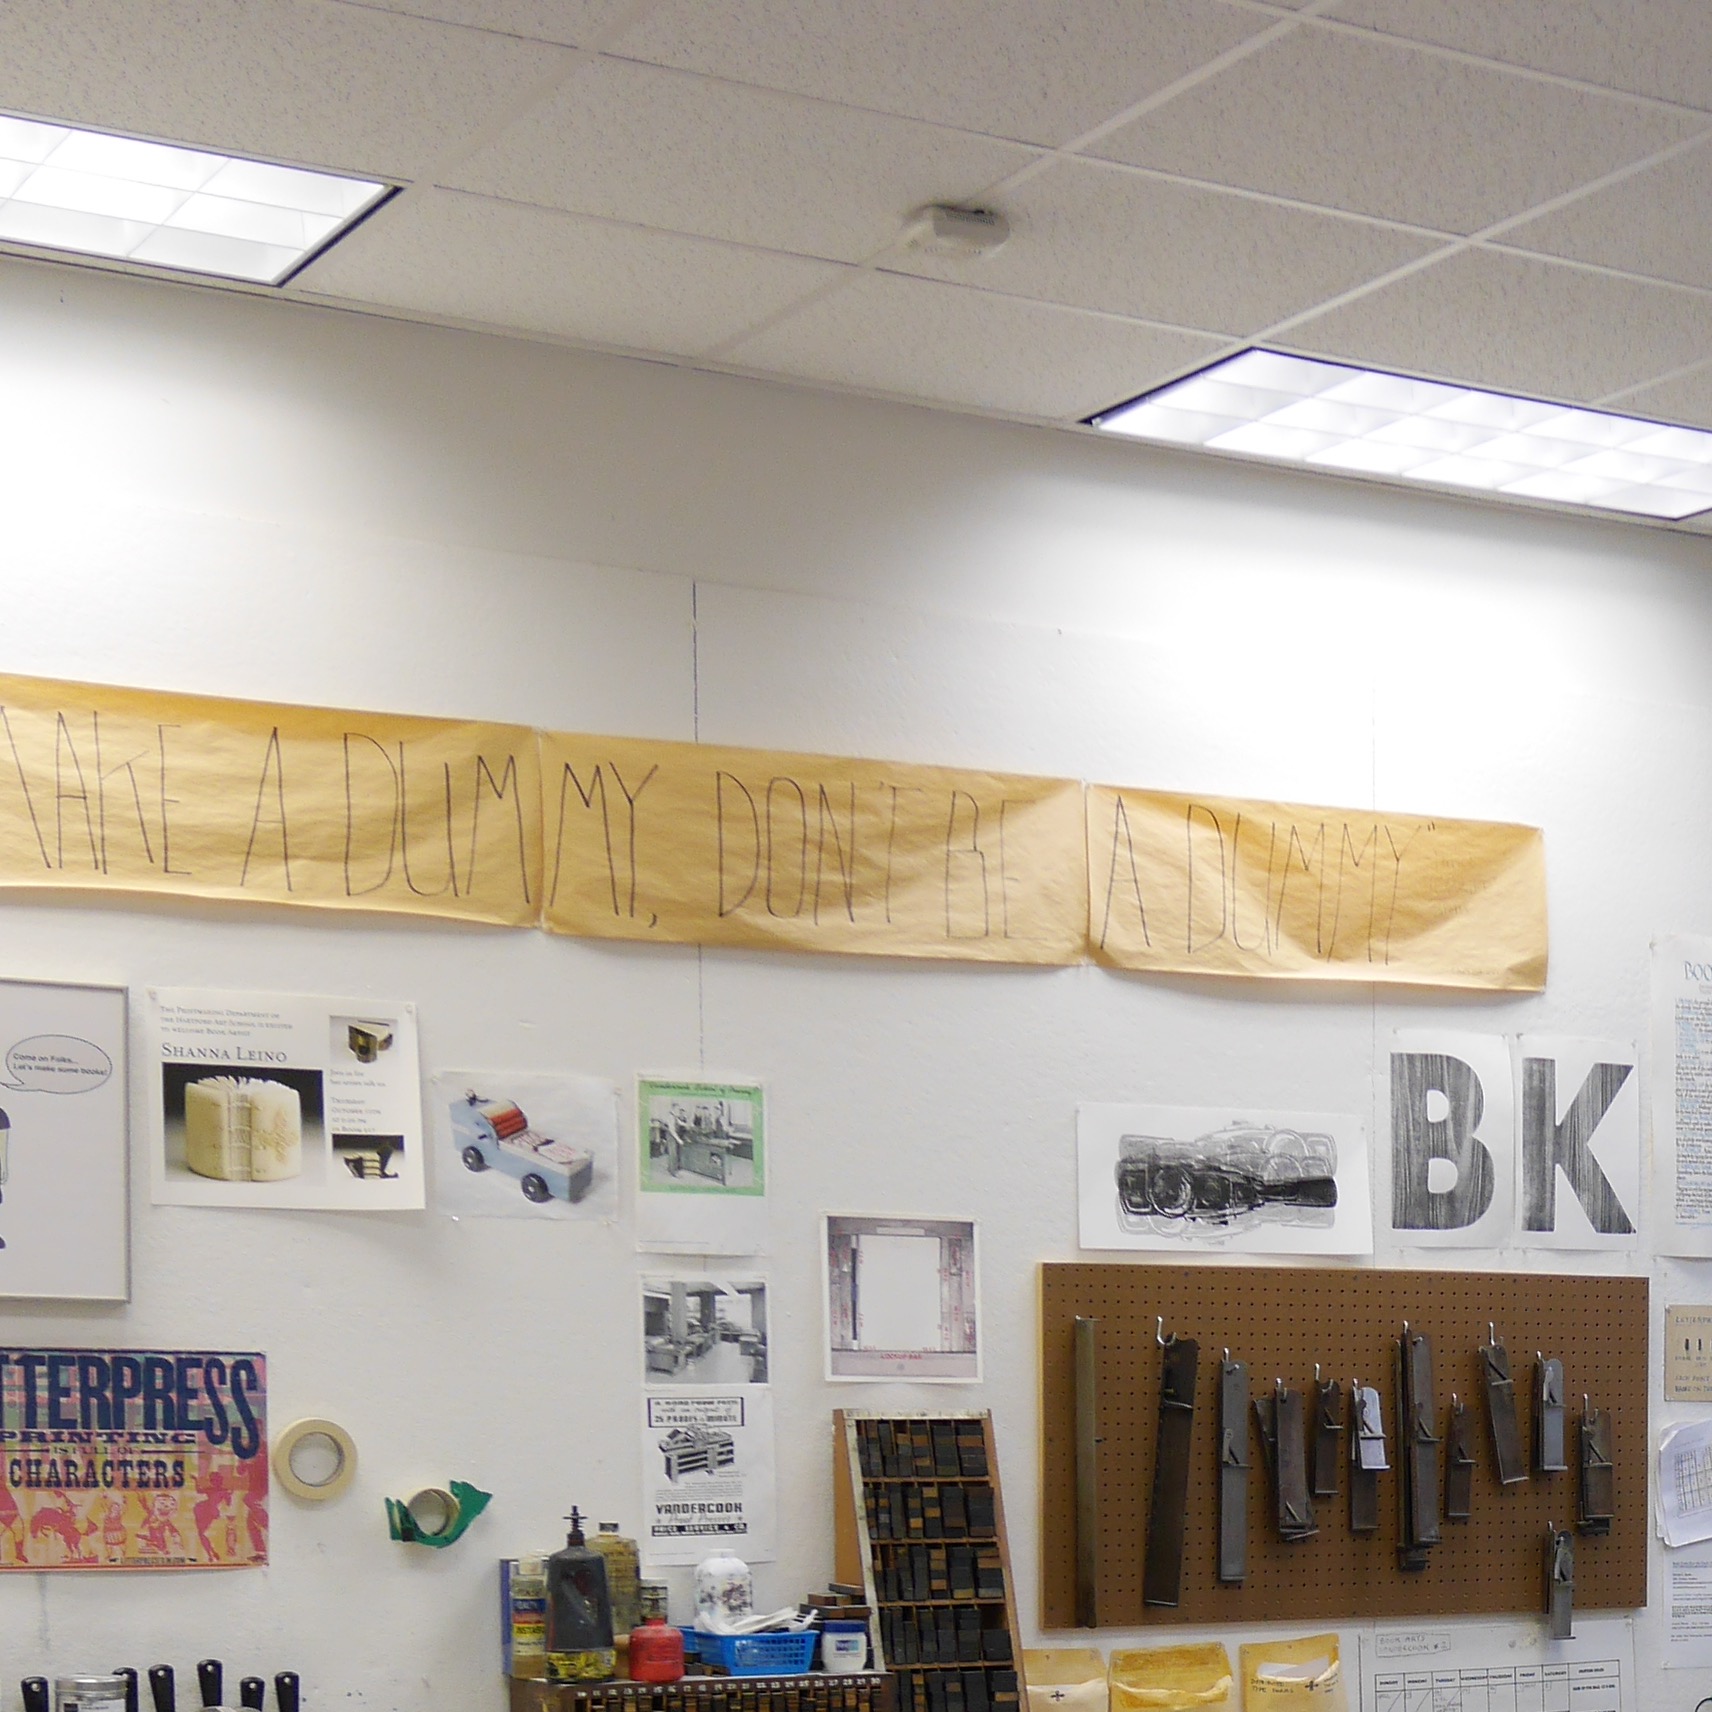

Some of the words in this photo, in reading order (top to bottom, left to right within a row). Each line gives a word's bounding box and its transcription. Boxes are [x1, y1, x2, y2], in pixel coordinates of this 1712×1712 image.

[240, 727, 292, 892] A
[946, 790, 1046, 940] BE
[1100, 795, 1151, 949] A
[161, 1042, 230, 1060] SHANNA
[236, 1046, 287, 1062] LEINO
[0, 1430, 197, 1444] PRINTING
[9, 1458, 185, 1489] CHARACTERS
[655, 1502, 743, 1515] VANDERCOOK
